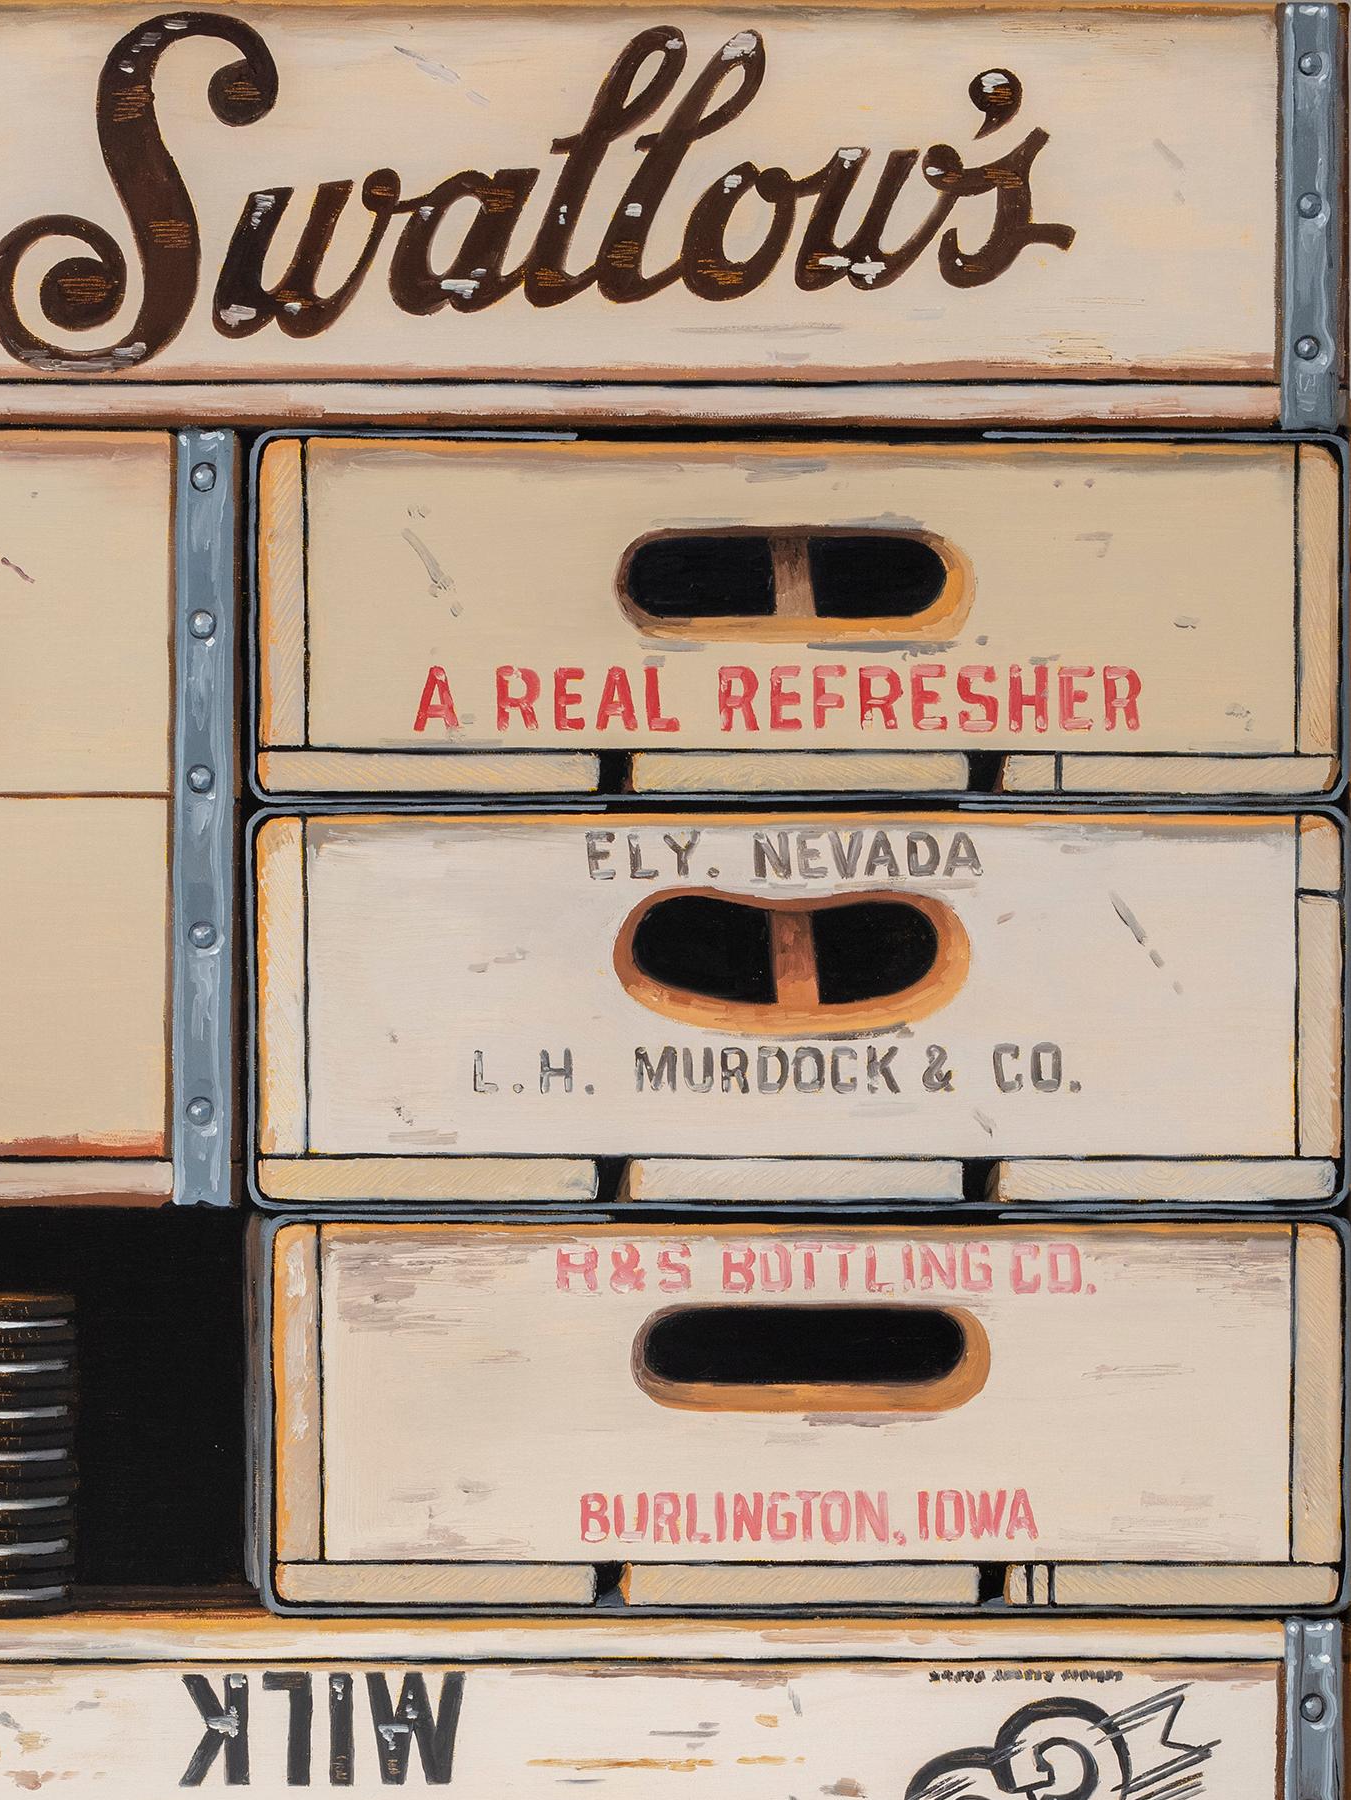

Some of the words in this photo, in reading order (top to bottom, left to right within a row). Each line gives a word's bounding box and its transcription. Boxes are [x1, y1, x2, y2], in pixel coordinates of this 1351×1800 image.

[413, 664, 460, 733] A
[495, 663, 681, 733] REAL
[718, 663, 1143, 734] REFRESHER
[752, 829, 985, 880] NEVADA
[633, 1044, 900, 1095] MURDOCK
[923, 1044, 956, 1094] &
[993, 1041, 1083, 1095] CO.
[721, 1243, 994, 1294] BOTTLING
[1010, 1243, 1098, 1295] CO.
[579, 1489, 907, 1546] BURLINGTON,
[919, 1487, 1039, 1543] IOWA
[178, 1670, 466, 1788] MILK
